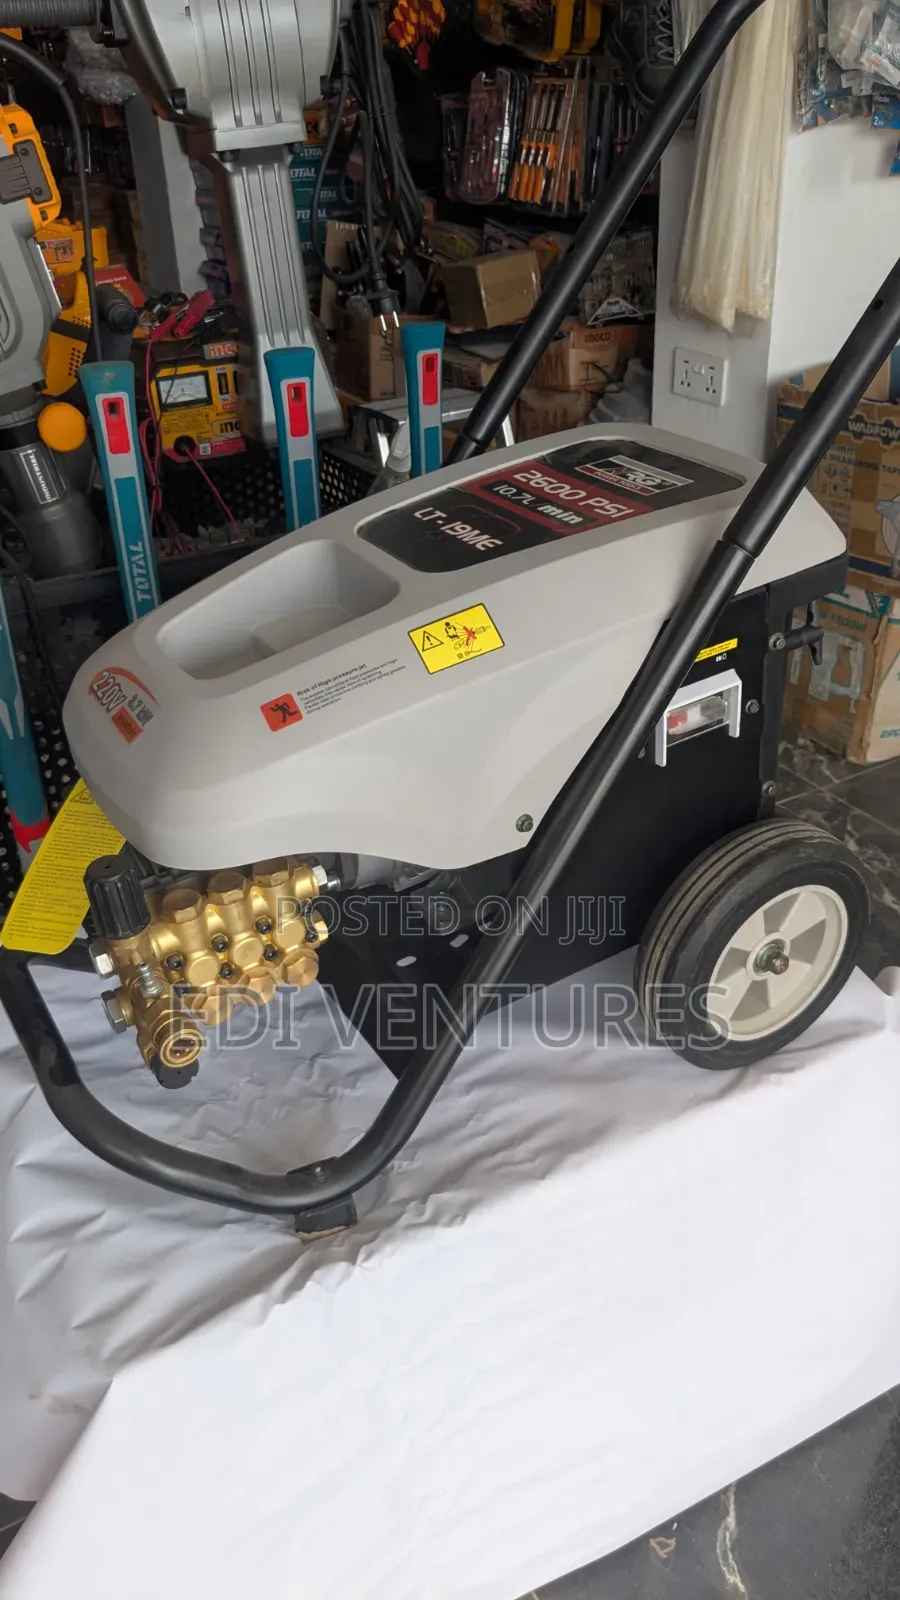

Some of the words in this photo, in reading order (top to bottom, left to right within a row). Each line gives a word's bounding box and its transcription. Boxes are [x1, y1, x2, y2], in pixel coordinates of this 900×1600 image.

[512, 470, 582, 502] 2600
[579, 496, 635, 519] PSI
[129, 541, 151, 602] TOTAL
[92, 670, 127, 712] 220V
